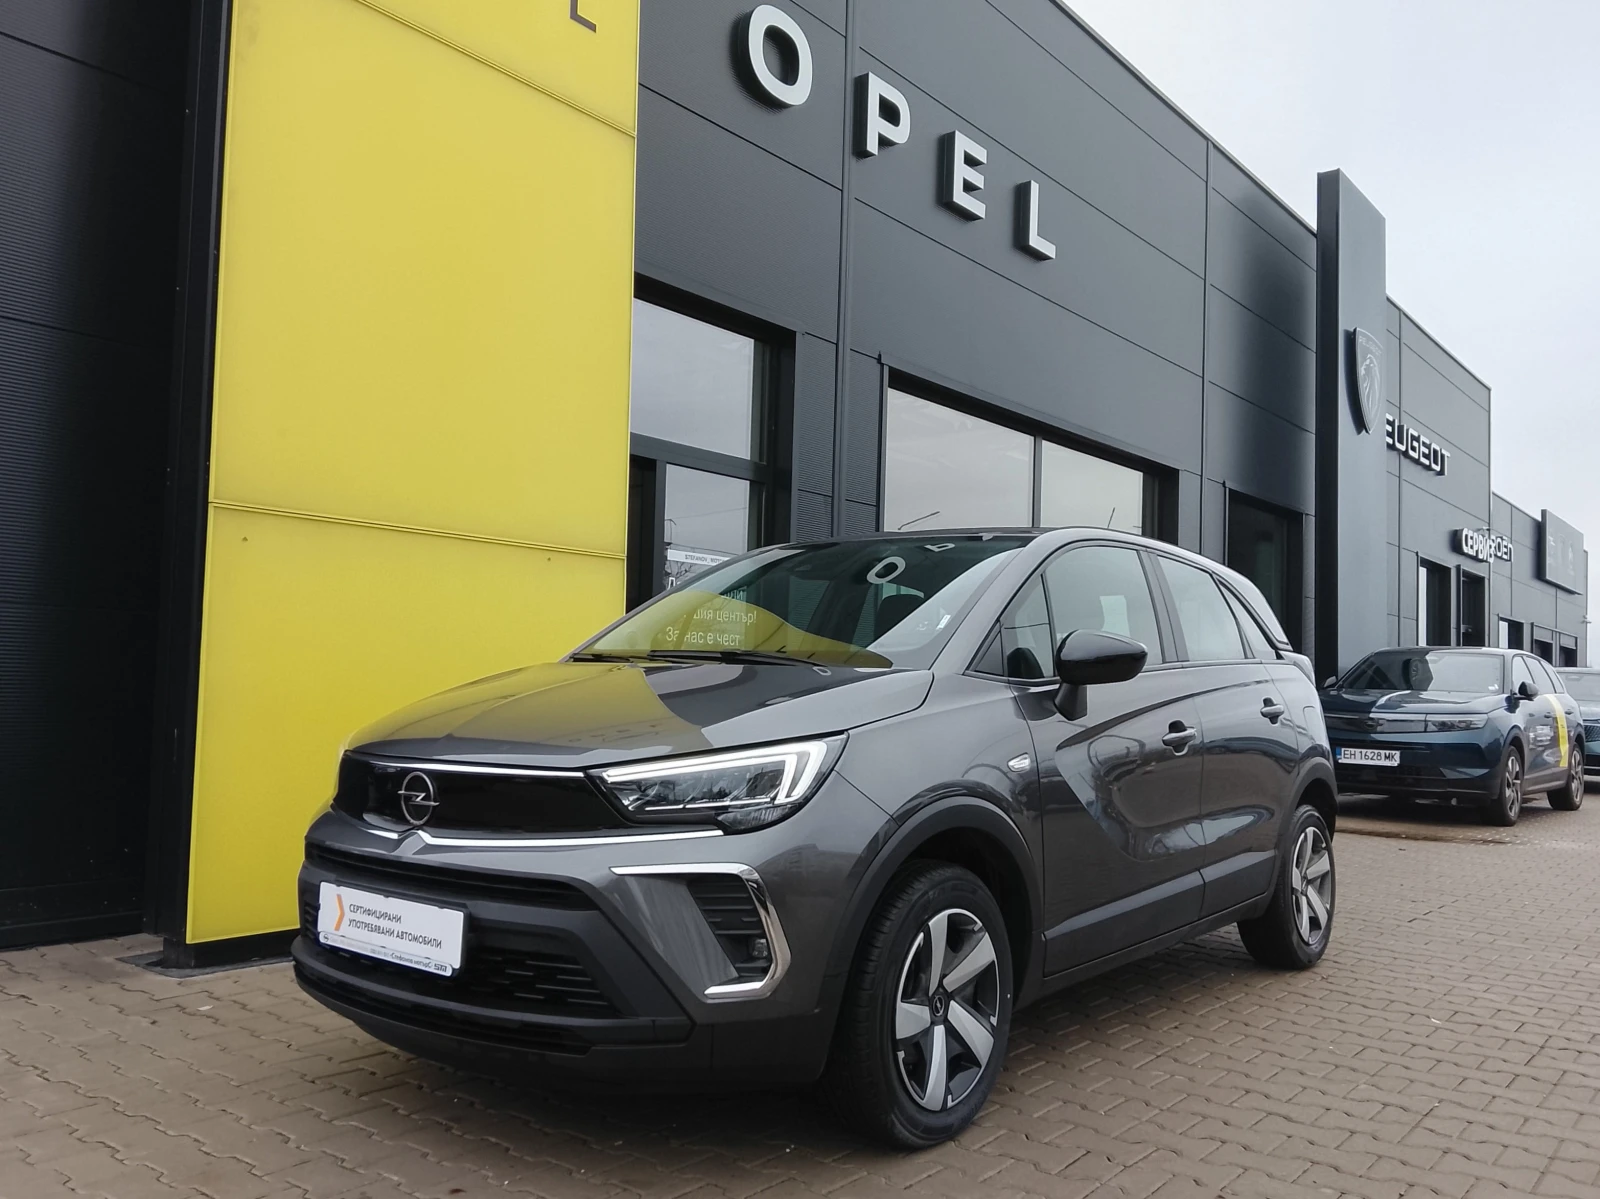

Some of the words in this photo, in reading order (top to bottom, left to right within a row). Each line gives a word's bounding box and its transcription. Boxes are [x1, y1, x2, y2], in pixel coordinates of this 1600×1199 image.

[748, 4, 1056, 260] OPEL
[1385, 412, 1451, 477] EUGEOT
[716, 610, 757, 626] център!
[717, 634, 741, 646] чест
[1359, 750, 1382, 761] 1628
[349, 903, 402, 924] СЕРТИФИЦИРАНИ
[348, 918, 395, 938] УПОТРЕБЯВАНИ
[395, 930, 443, 950] АВТОМОБИЛИ
